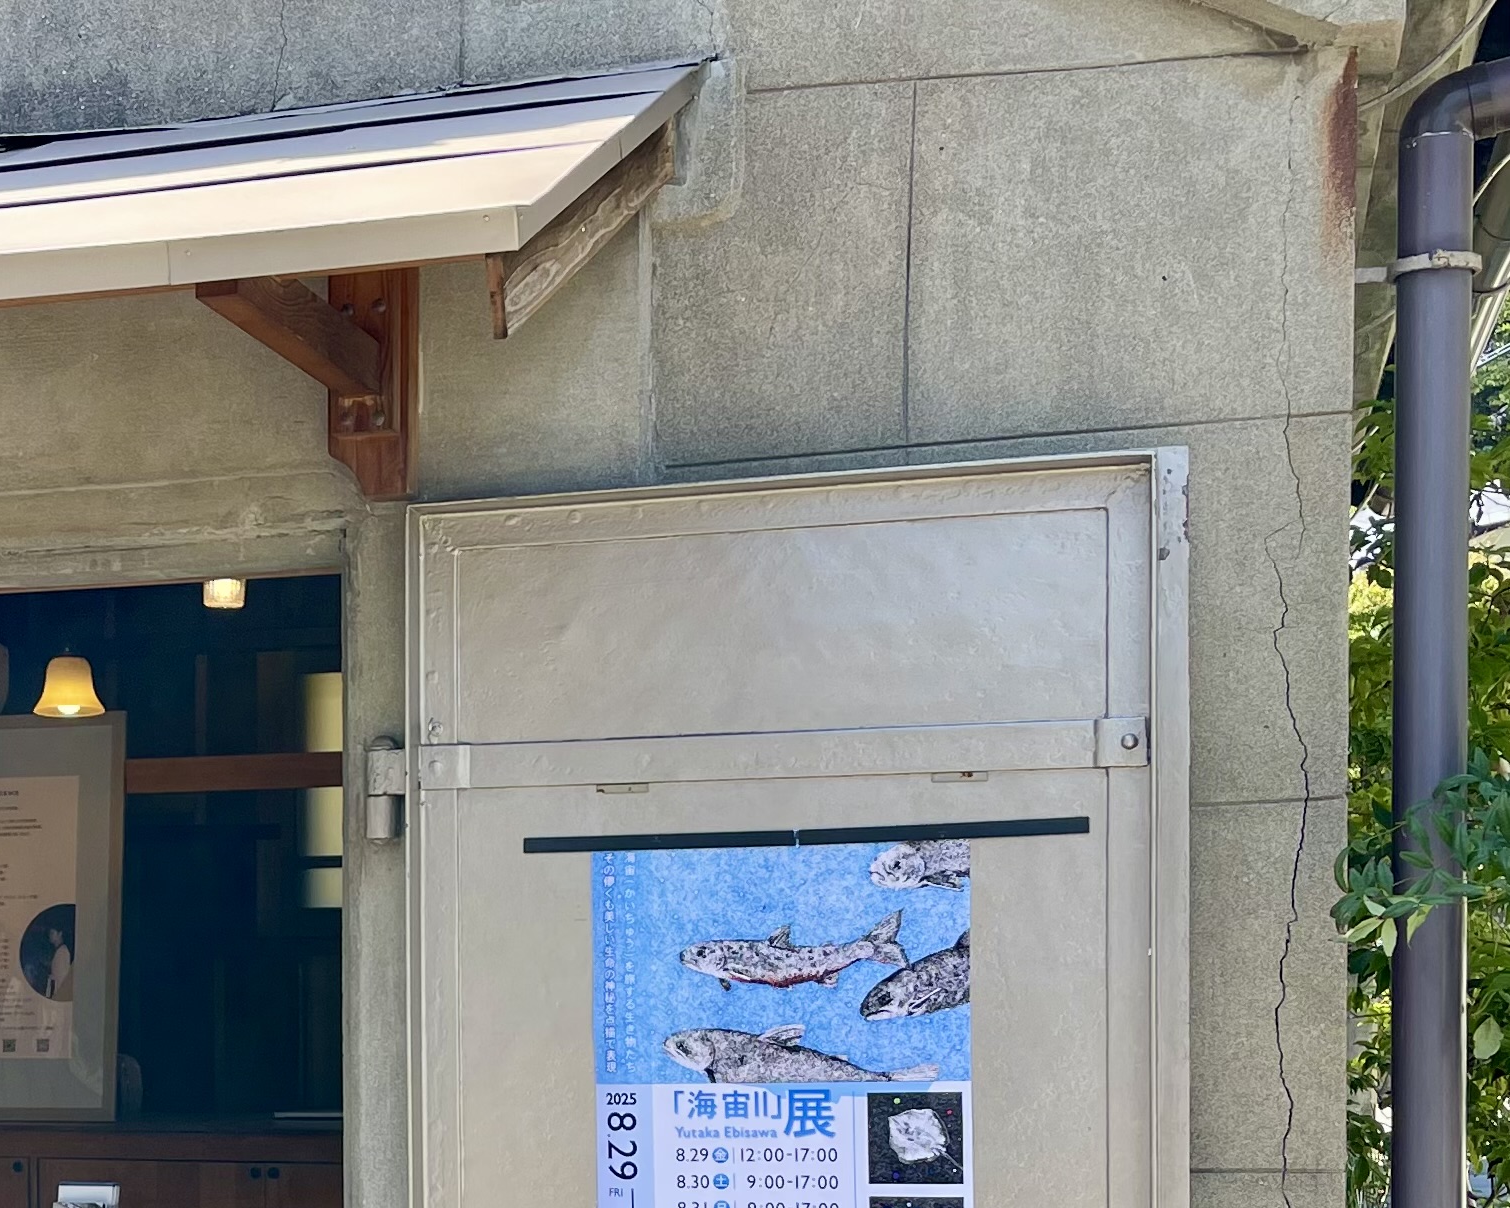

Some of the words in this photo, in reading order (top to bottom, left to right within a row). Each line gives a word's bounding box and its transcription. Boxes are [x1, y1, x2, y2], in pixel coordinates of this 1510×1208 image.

[606, 1092, 637, 1106] 2025
[675, 1126, 720, 1138] Yutaka
[724, 1126, 778, 1139] Ebisawa
[607, 1112, 638, 1180] 8.29
[676, 1148, 709, 1162] 8.29
[740, 1148, 838, 1162] 12:00-17:00
[677, 1174, 710, 1189] 8.30
[747, 1174, 839, 1190] 9:00-17:00
[609, 1187, 624, 1198] FRI
